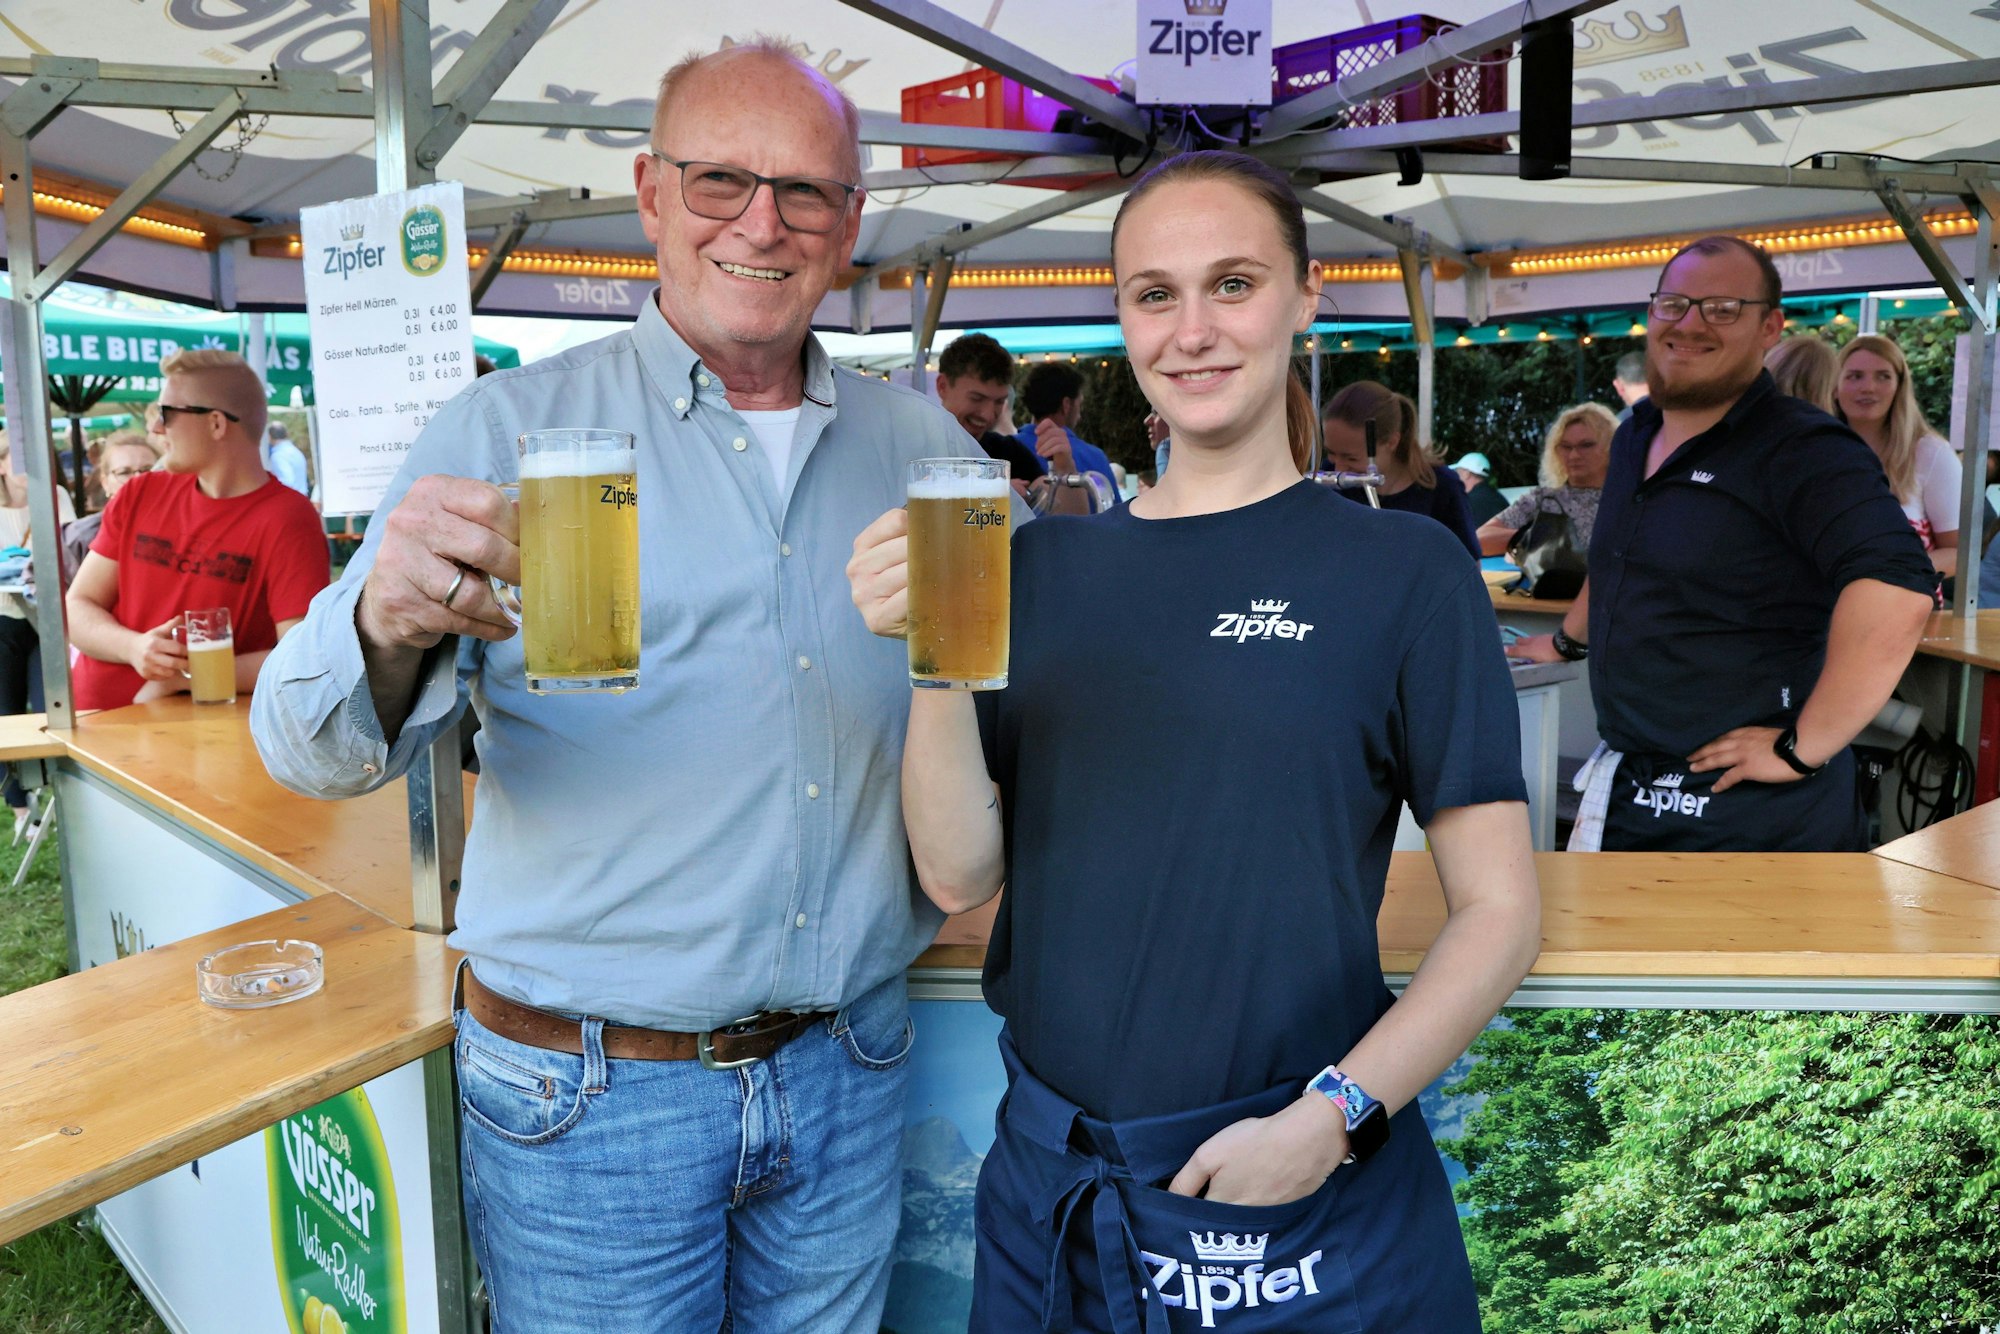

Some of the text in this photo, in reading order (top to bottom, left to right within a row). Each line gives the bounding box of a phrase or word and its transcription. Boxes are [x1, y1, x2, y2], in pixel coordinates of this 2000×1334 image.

[1149, 20, 1262, 67] Zipfer
[323, 242, 386, 281] Zipfer
[320, 304, 343, 316] Zipfer
[345, 301, 362, 312] Hell
[437, 303, 457, 316] 4,00
[439, 319, 458, 332] 6,00
[43, 333, 100, 361] BLE
[324, 342, 407, 361] Gösser NaturRadler
[441, 351, 461, 363] 4,00
[443, 366, 462, 379] 6,00
[963, 508, 1006, 531] Zipfer
[1209, 613, 1314, 643] Zipfer
[1200, 1265, 1235, 1276] 1858
[1140, 1249, 1323, 1328] Zipfer
